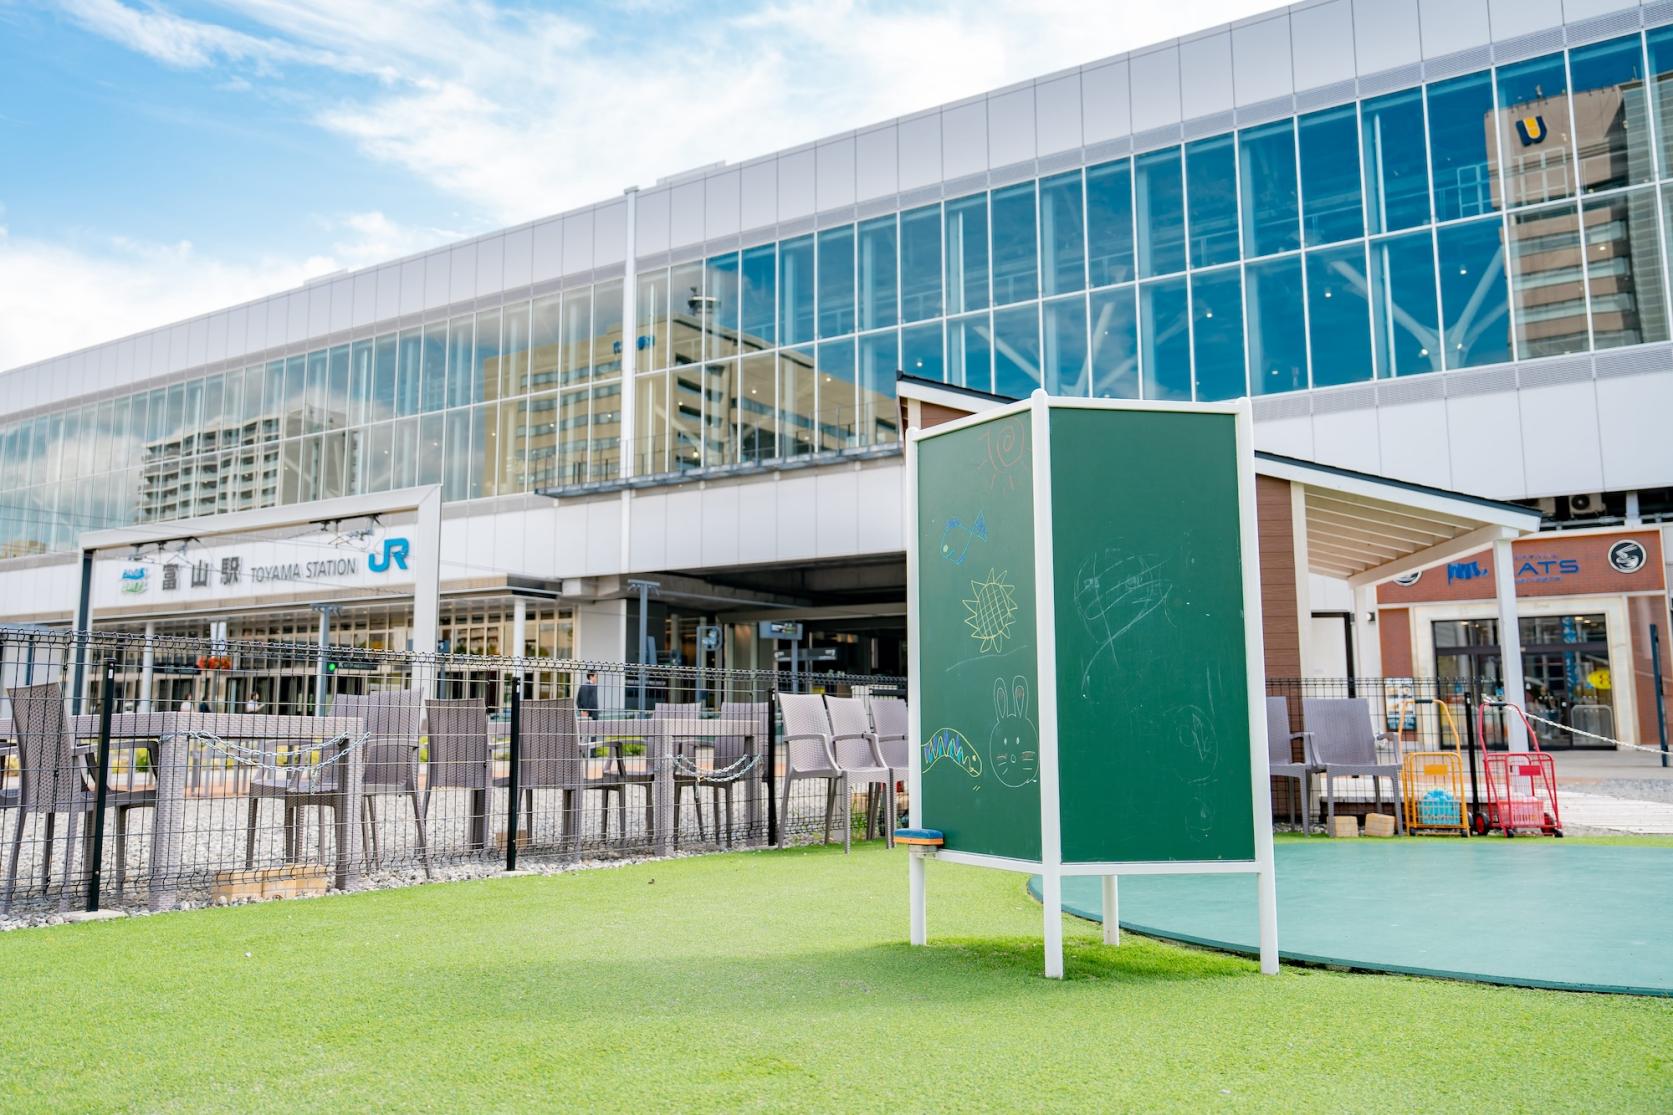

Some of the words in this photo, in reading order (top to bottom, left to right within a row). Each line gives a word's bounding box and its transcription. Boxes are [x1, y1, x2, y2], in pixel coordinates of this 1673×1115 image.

[250, 563, 301, 583] TOYAMA
[306, 557, 357, 579] STATION
[368, 537, 411, 573] JR
[1518, 559, 1579, 576] ATS
[162, 556, 240, 591] 富山駅
